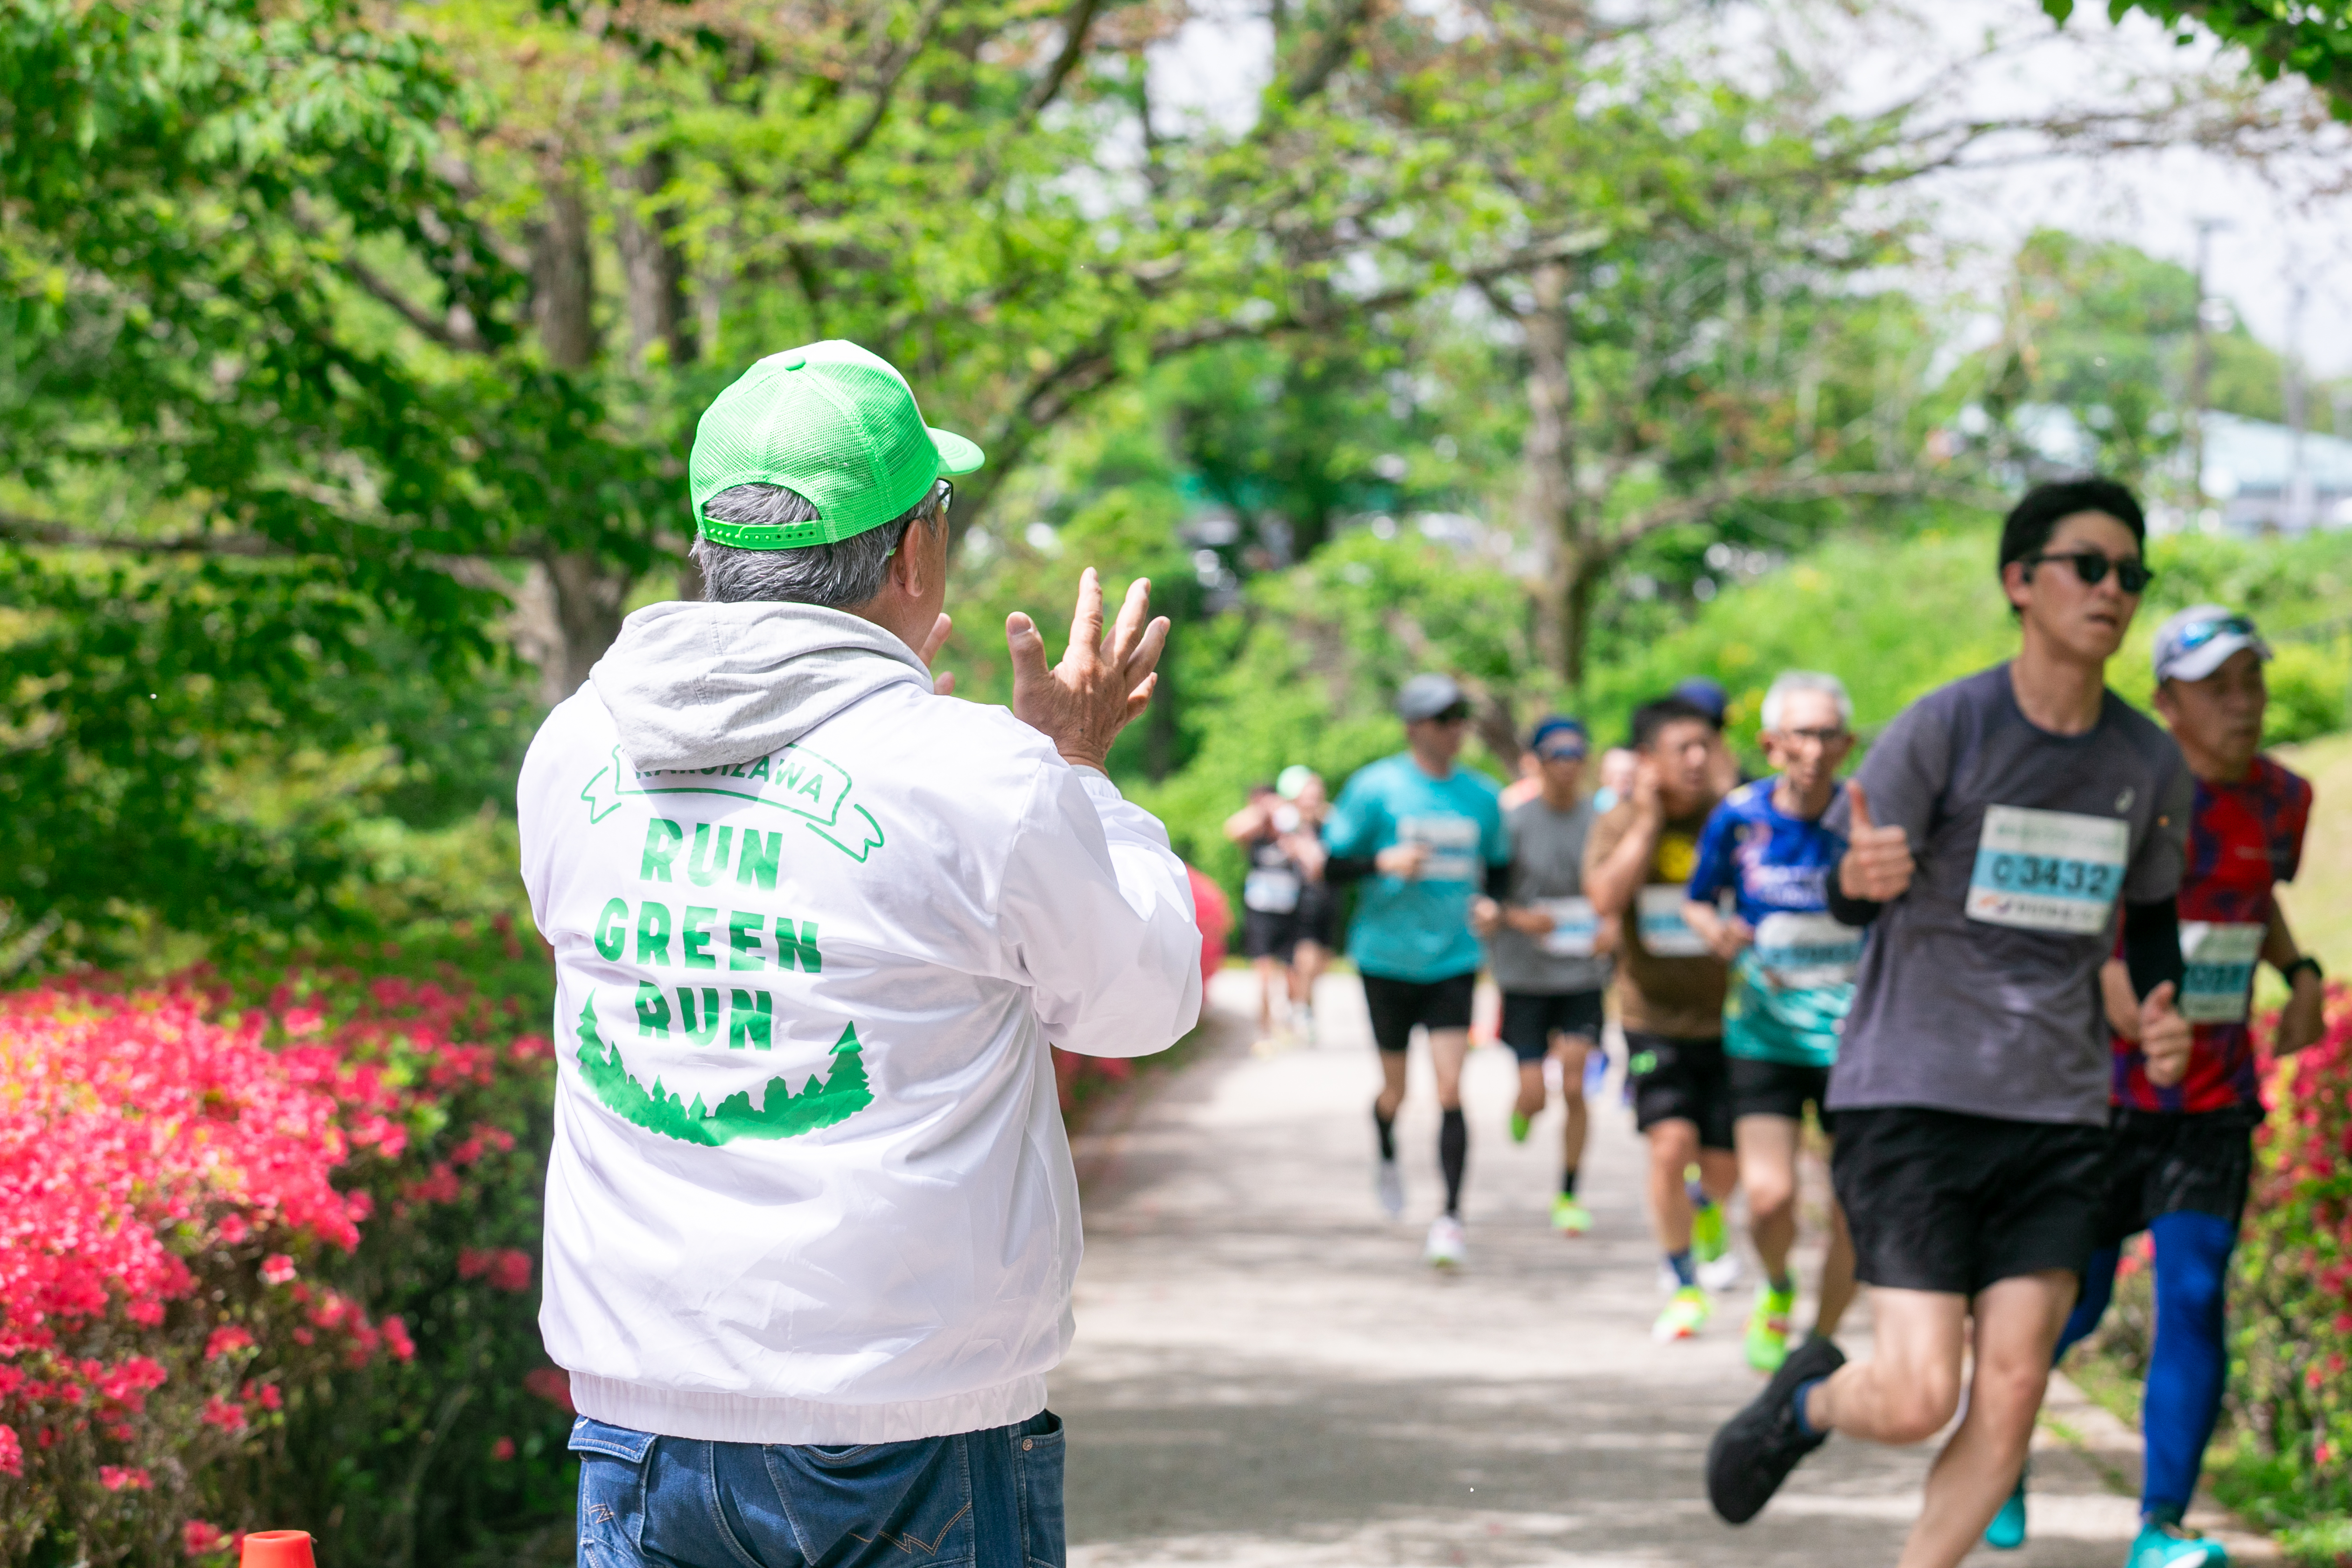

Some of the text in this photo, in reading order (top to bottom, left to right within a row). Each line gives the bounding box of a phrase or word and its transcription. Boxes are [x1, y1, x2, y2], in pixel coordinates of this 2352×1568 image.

[639, 818, 783, 892] RUN
[594, 897, 822, 973] GREEN
[635, 980, 773, 1051] RUN
